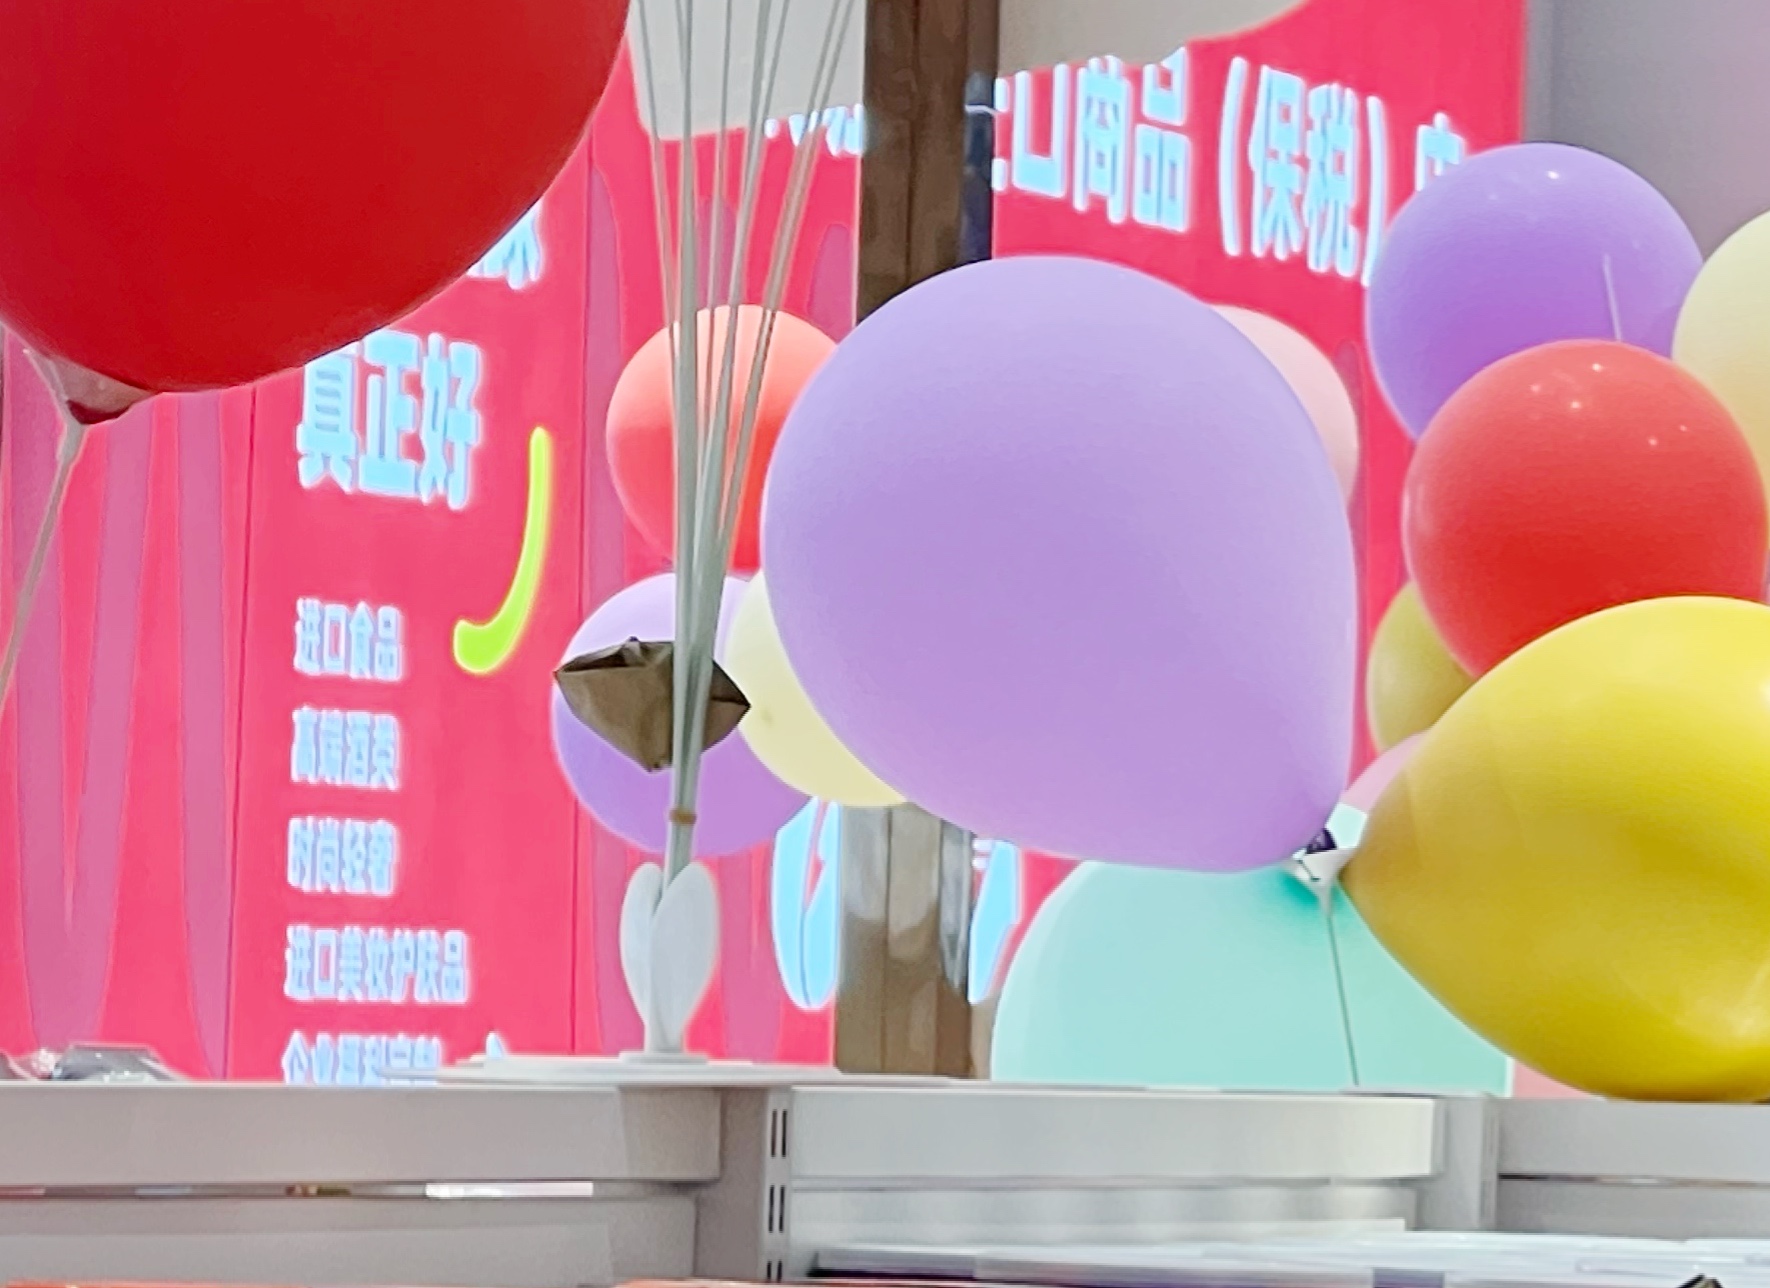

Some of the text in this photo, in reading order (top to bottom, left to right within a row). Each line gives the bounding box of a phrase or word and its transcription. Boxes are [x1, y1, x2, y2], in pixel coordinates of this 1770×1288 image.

[993, 46, 1465, 286] 口商品（保税）
[296, 328, 480, 509] 真正好
[293, 597, 403, 682] 进口食品
[290, 705, 400, 790] 高端酒类
[283, 923, 470, 1004] 进口美妆护肤品
